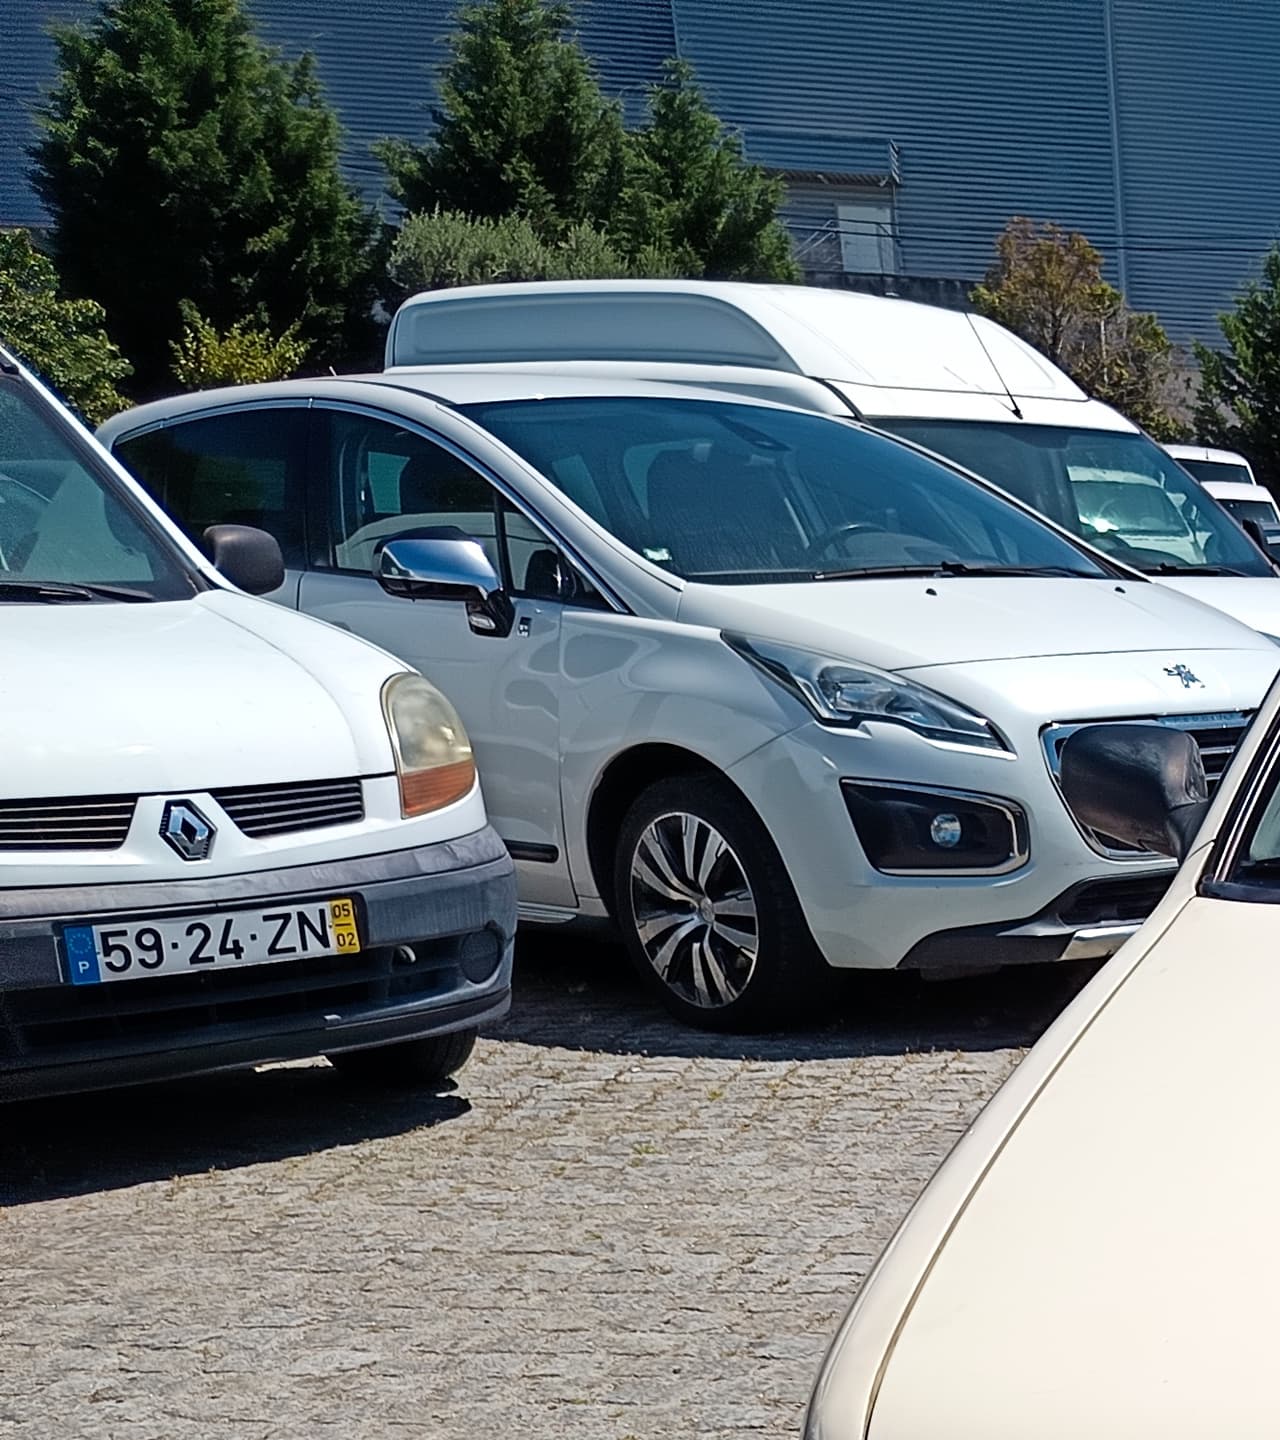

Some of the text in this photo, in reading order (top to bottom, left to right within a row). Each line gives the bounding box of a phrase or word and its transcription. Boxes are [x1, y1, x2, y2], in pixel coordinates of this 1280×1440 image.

[333, 904, 351, 919] 05
[336, 932, 356, 947] 02
[78, 961, 90, 974] P
